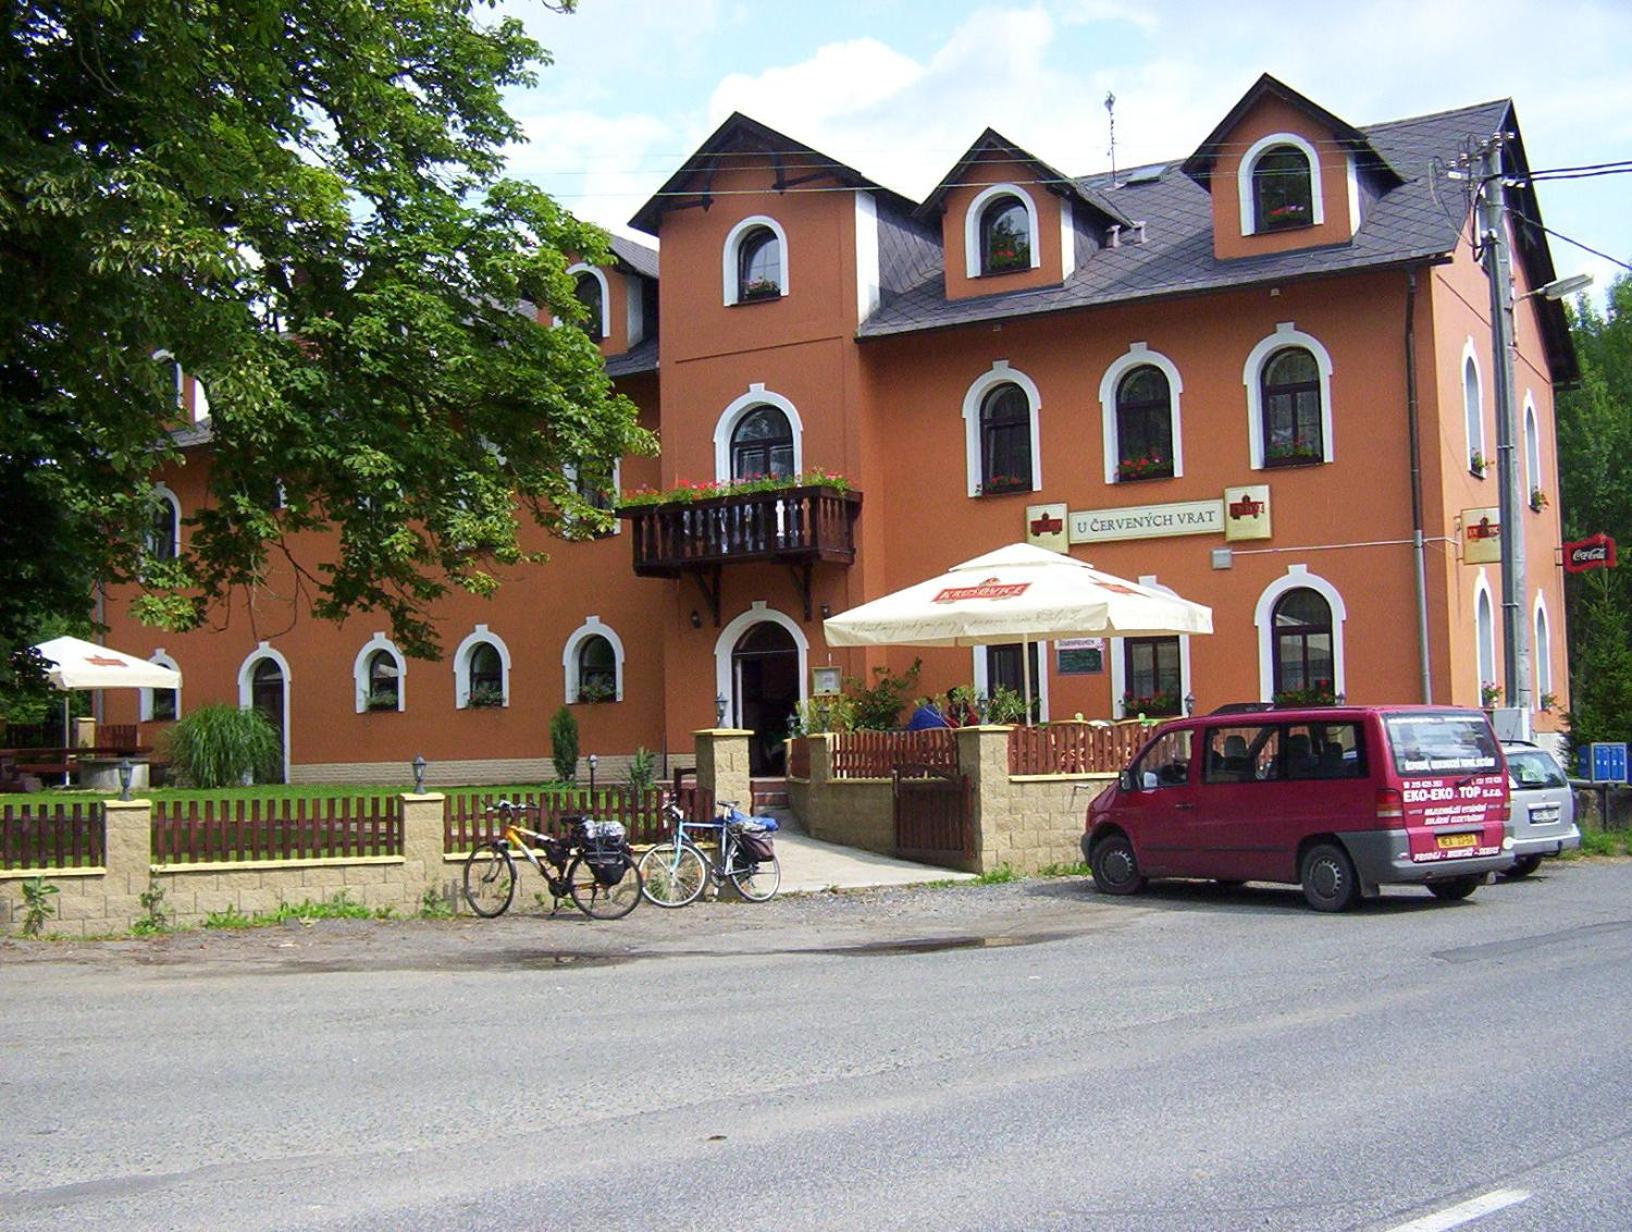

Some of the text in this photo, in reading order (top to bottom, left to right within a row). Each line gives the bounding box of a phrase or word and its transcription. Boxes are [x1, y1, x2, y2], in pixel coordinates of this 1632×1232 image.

[1076, 522, 1087, 533] U
[1090, 513, 1173, 533] ČERVENÝCH
[1177, 510, 1216, 524] VRAT
[1458, 786, 1481, 798] TOP
